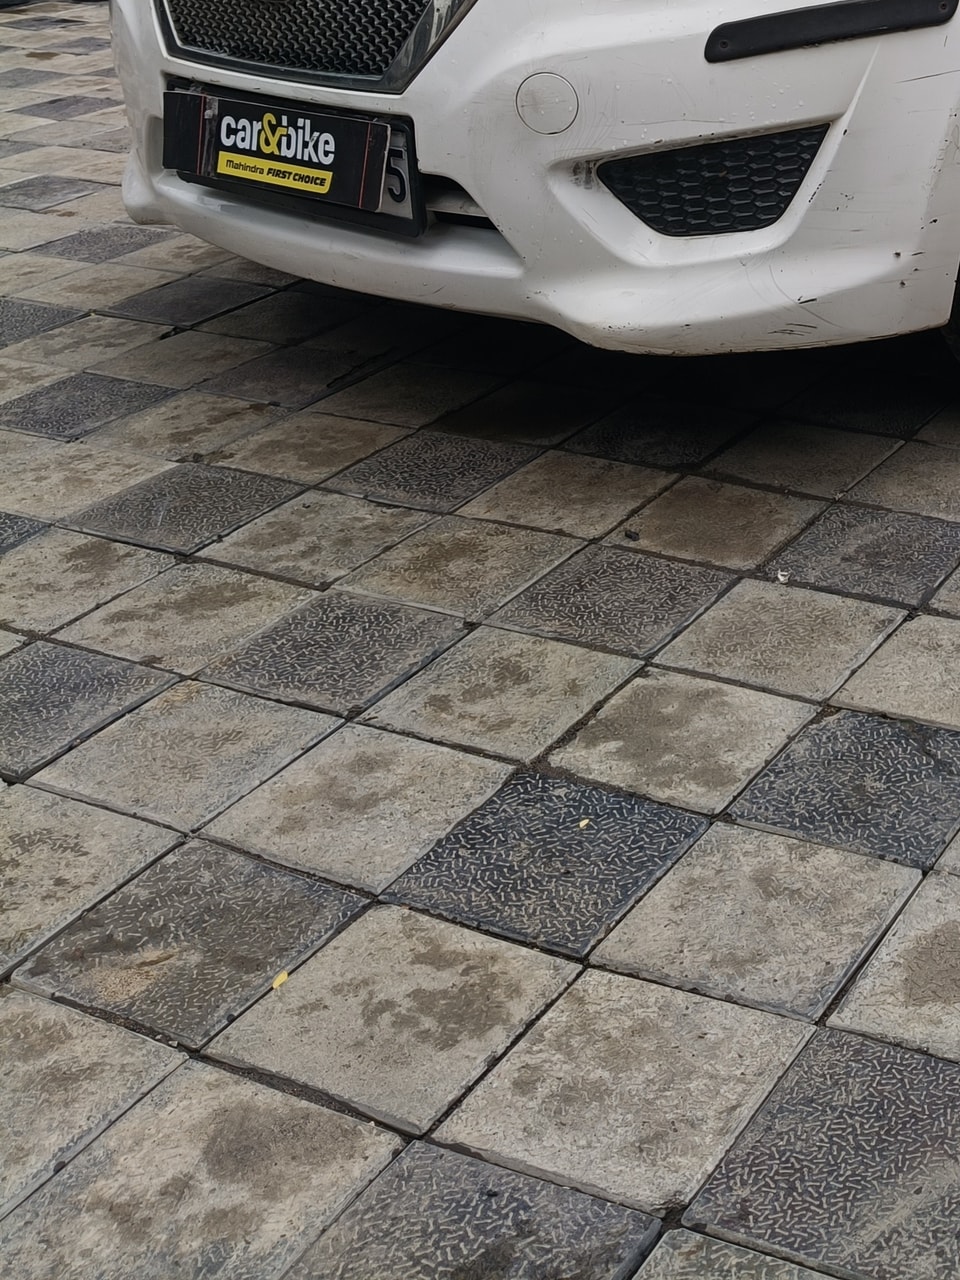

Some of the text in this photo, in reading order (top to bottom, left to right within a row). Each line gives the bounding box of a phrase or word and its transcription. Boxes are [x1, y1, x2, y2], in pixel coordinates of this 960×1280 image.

[220, 112, 336, 166] car&bike
[225, 159, 327, 187] Mahindra FIRST CHOICE
